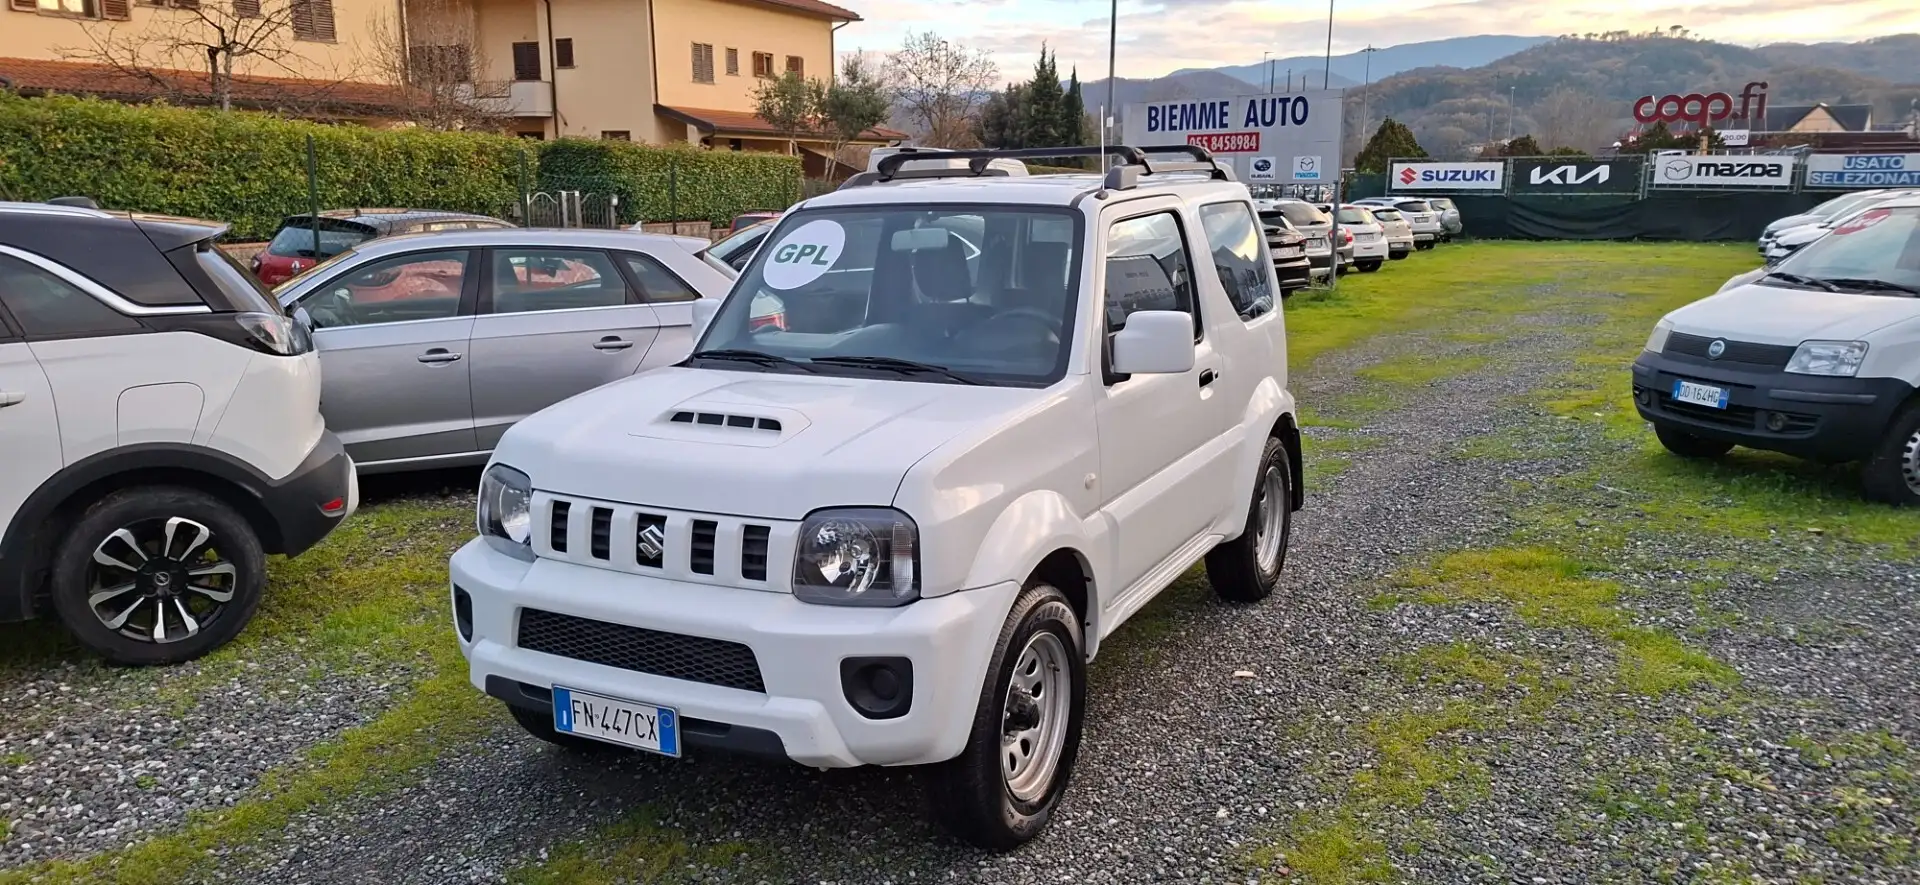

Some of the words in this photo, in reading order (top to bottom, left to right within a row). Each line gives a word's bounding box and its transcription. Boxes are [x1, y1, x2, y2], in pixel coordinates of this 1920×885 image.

[1633, 81, 1769, 129] coop.fi
[1147, 101, 1229, 132] BIEMME
[1244, 96, 1309, 128] AUTO
[1189, 136, 1208, 149] 055
[1210, 134, 1257, 151] 8458984
[1844, 156, 1905, 169] USATO
[1421, 169, 1495, 182] SUZUKI
[1811, 172, 1920, 185] SELEZIONAT
[774, 243, 829, 266] GPL
